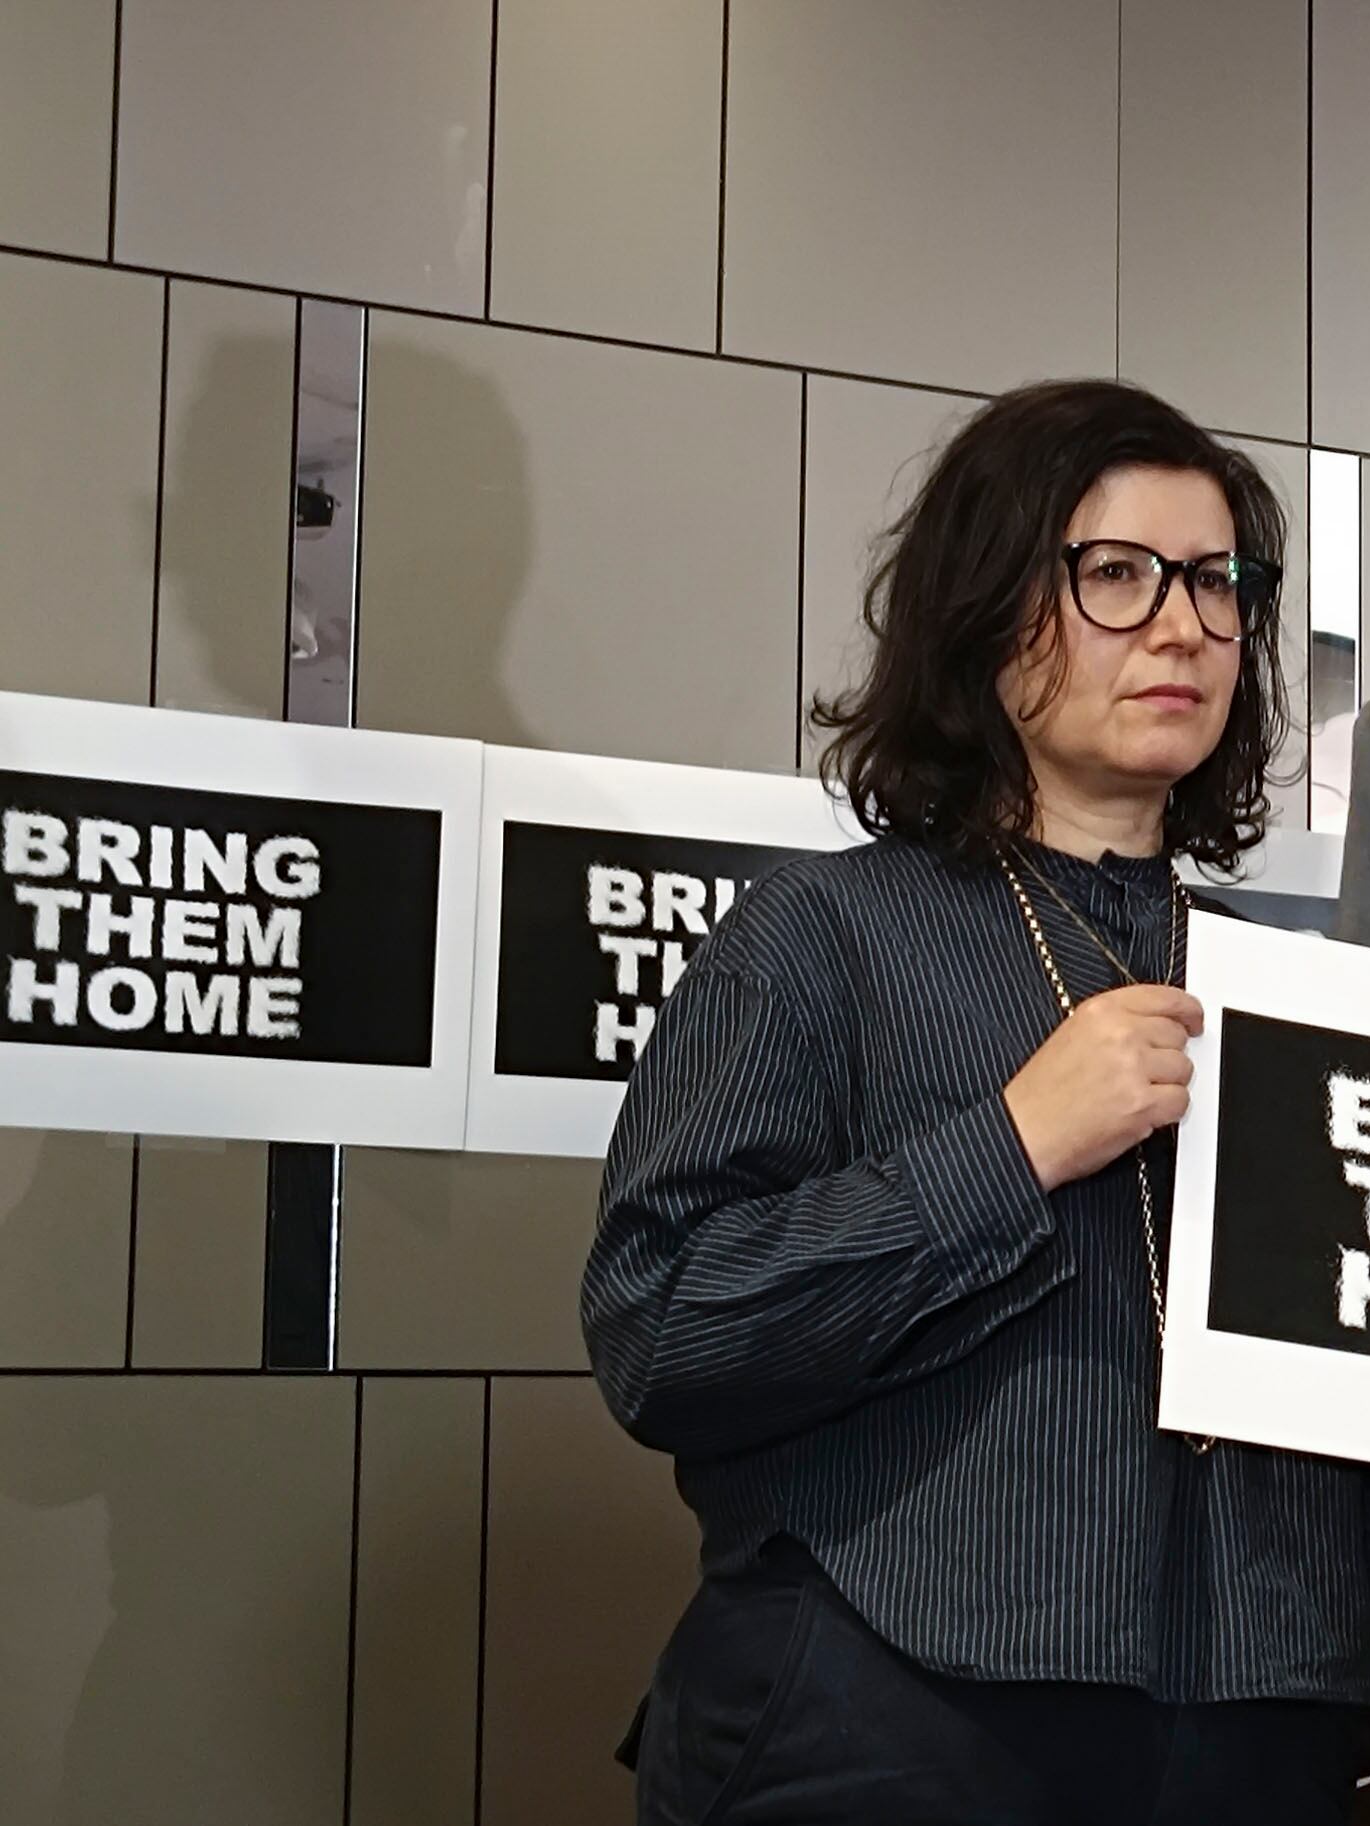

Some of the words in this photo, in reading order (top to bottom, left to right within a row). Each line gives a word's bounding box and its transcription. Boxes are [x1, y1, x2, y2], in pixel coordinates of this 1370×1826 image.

[2, 808, 321, 899] BRING
[14, 883, 302, 969] THEM
[588, 863, 751, 934] BRI
[8, 956, 303, 1039] HOME
